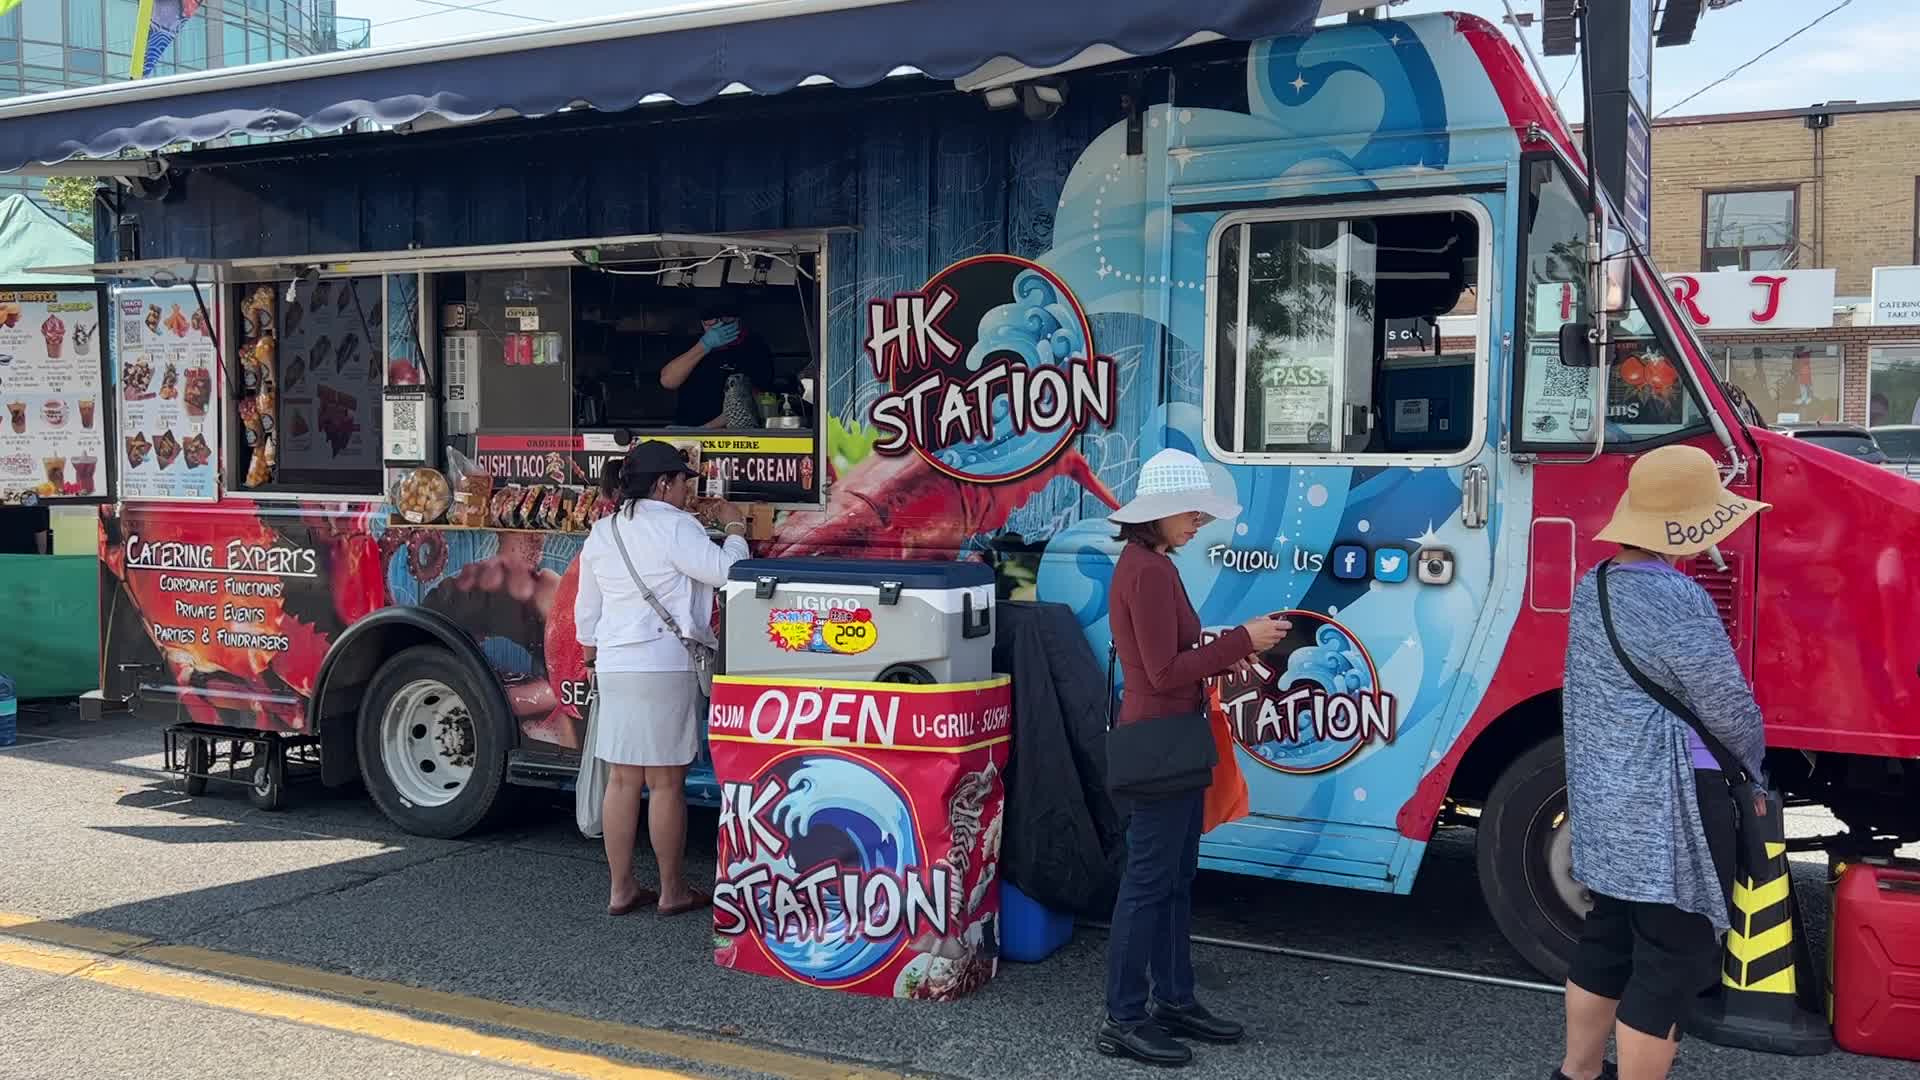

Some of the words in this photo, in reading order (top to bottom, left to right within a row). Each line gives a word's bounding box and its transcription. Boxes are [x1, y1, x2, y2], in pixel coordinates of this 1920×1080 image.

[1751, 275, 1788, 323] J
[867, 289, 957, 376] HK
[1273, 366, 1322, 386] PASS
[873, 360, 1109, 449] STATION
[718, 440, 731, 449] UP
[732, 441, 760, 450] HERE
[478, 455, 512, 478] SUSHI
[514, 455, 545, 478] TACO
[1664, 501, 1749, 546] Beach
[126, 535, 213, 568] CATERING
[227, 539, 317, 574] EXPERTS
[159, 574, 218, 594] CORPORATE
[224, 577, 282, 597] FUNCTIONS
[175, 600, 216, 620] PRIVATE
[223, 603, 265, 623] EVENTS
[154, 624, 195, 643] PARTIES
[201, 627, 210, 642] &
[216, 630, 289, 651] FUNDRAISERS
[749, 689, 900, 745] OPEN
[912, 712, 975, 738] U-GRILL
[1220, 689, 1391, 741] TATION
[712, 865, 947, 938] STATION
